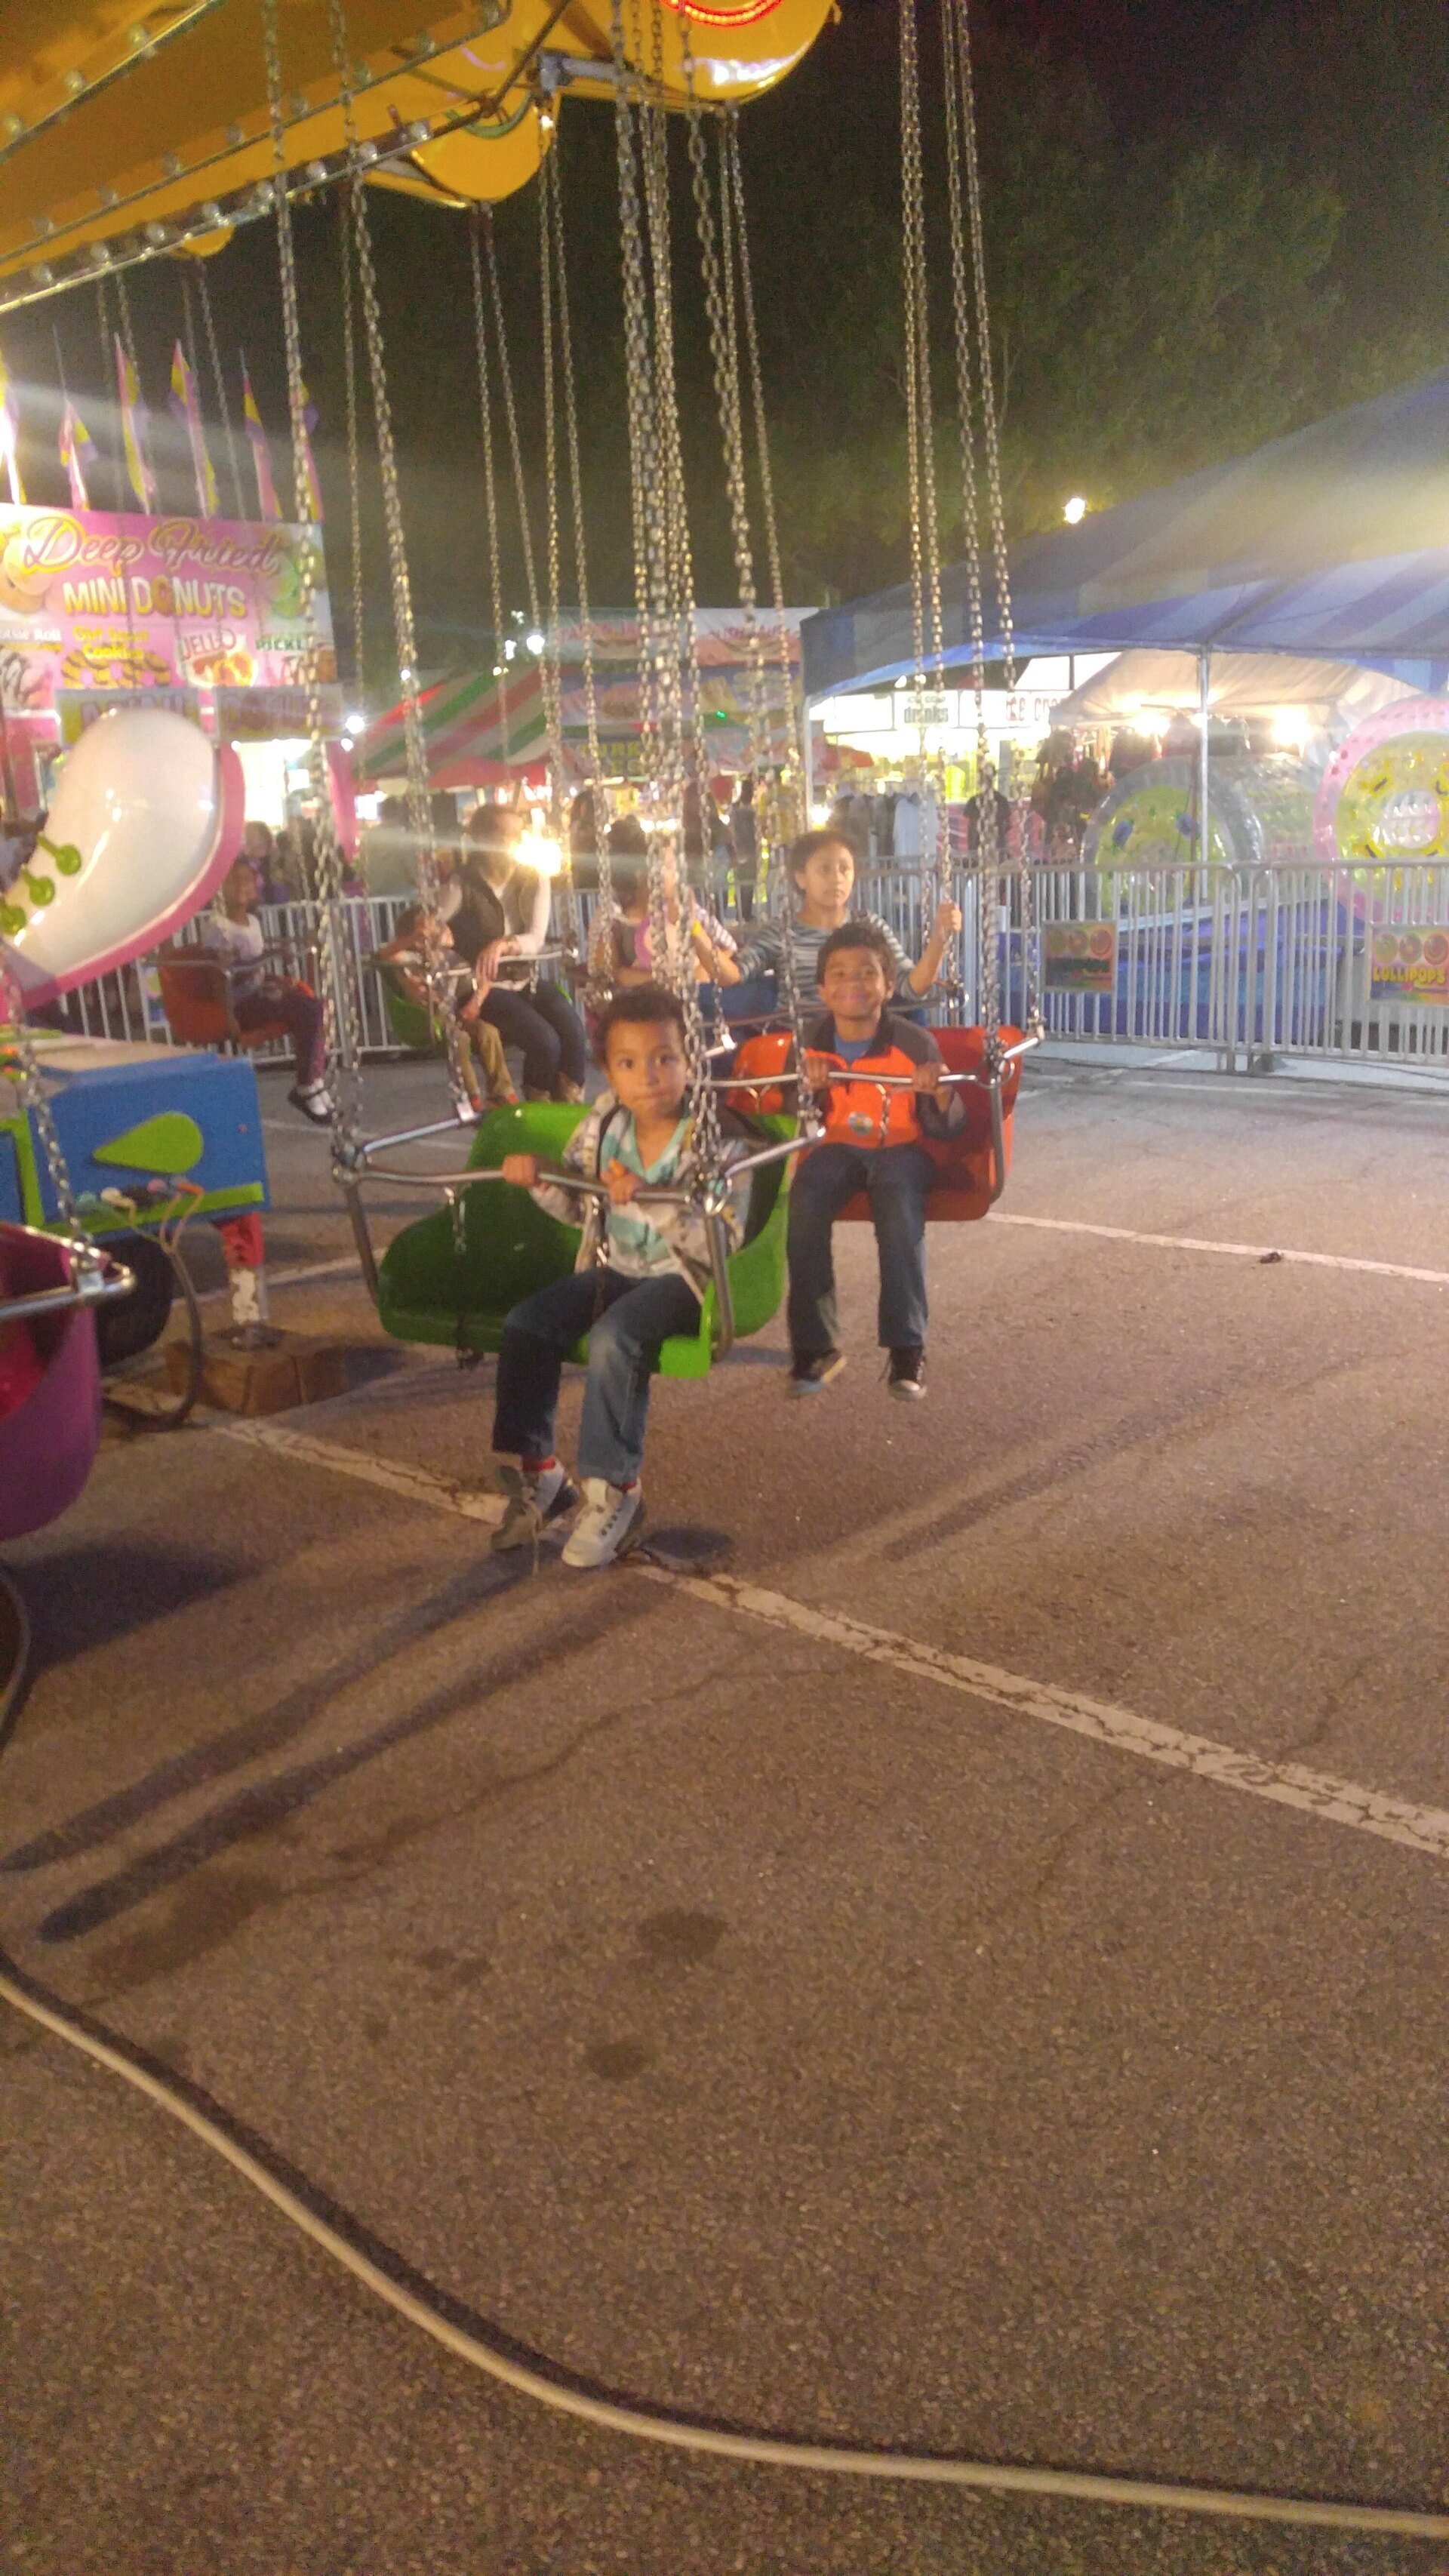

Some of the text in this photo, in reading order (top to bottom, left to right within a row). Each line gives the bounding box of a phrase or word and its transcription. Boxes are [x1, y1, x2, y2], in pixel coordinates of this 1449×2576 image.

[20, 516, 285, 576] Deep Fried
[63, 576, 247, 617] MINI DONUTS
[1374, 967, 1446, 984] LOLLIPOPS
